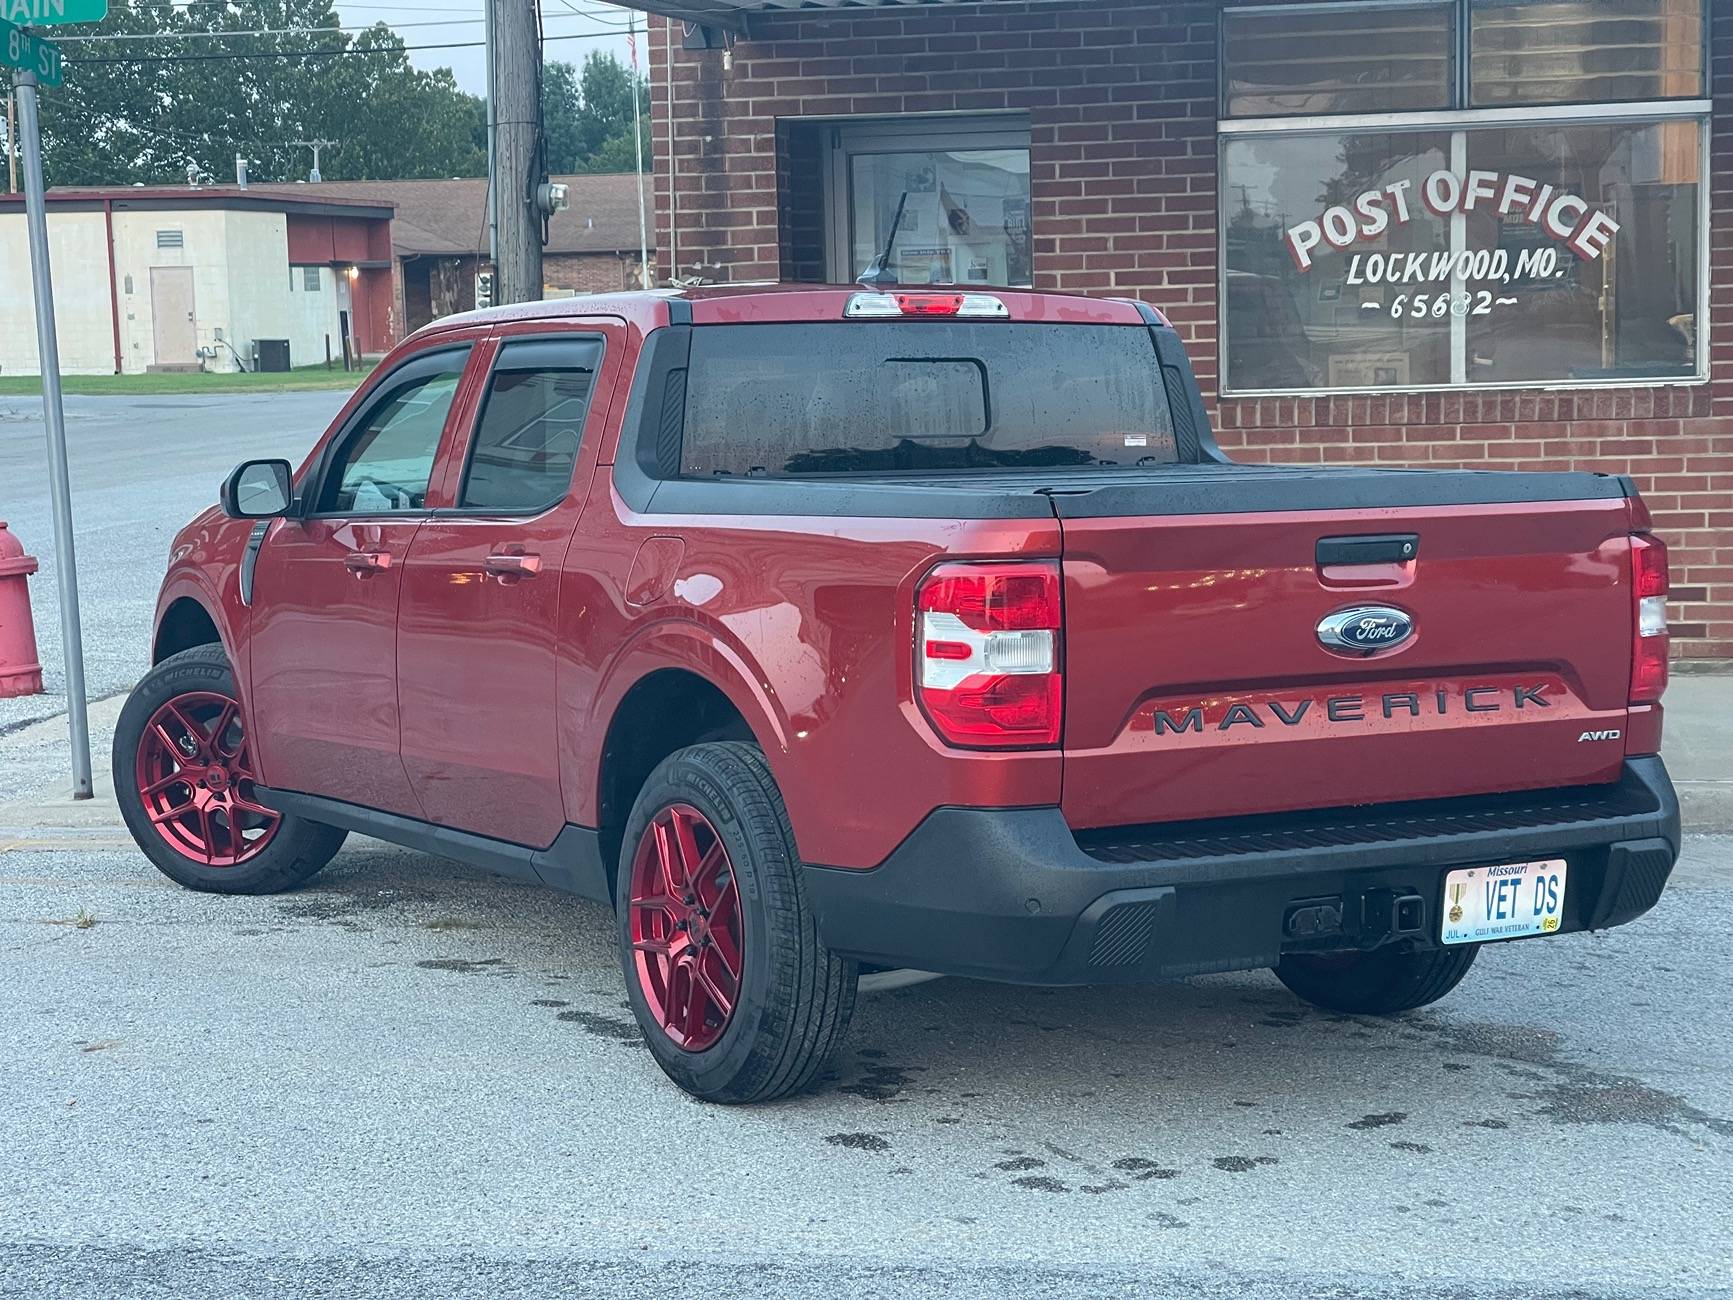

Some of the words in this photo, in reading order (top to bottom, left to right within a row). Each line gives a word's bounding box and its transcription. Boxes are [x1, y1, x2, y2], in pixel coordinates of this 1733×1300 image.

[9, 29, 31, 61] 8TH
[38, 44, 58, 79] ST
[1286, 179, 1412, 270] POST
[1425, 169, 1621, 260] OFFICE
[1346, 248, 1510, 286] LOCKWOOD,
[1513, 247, 1565, 280] MO.
[1355, 616, 1398, 641] Ford
[1154, 683, 1551, 736] MAVERICK
[1577, 729, 1621, 742] AWD
[1487, 863, 1528, 877] Missouri
[1486, 878, 1521, 921] VET
[1533, 874, 1559, 916] DS
[1446, 929, 1460, 939] JUL
[1475, 928, 1490, 937] GULF
[1491, 926, 1503, 935] WAR
[1505, 924, 1529, 933] VETERAN
